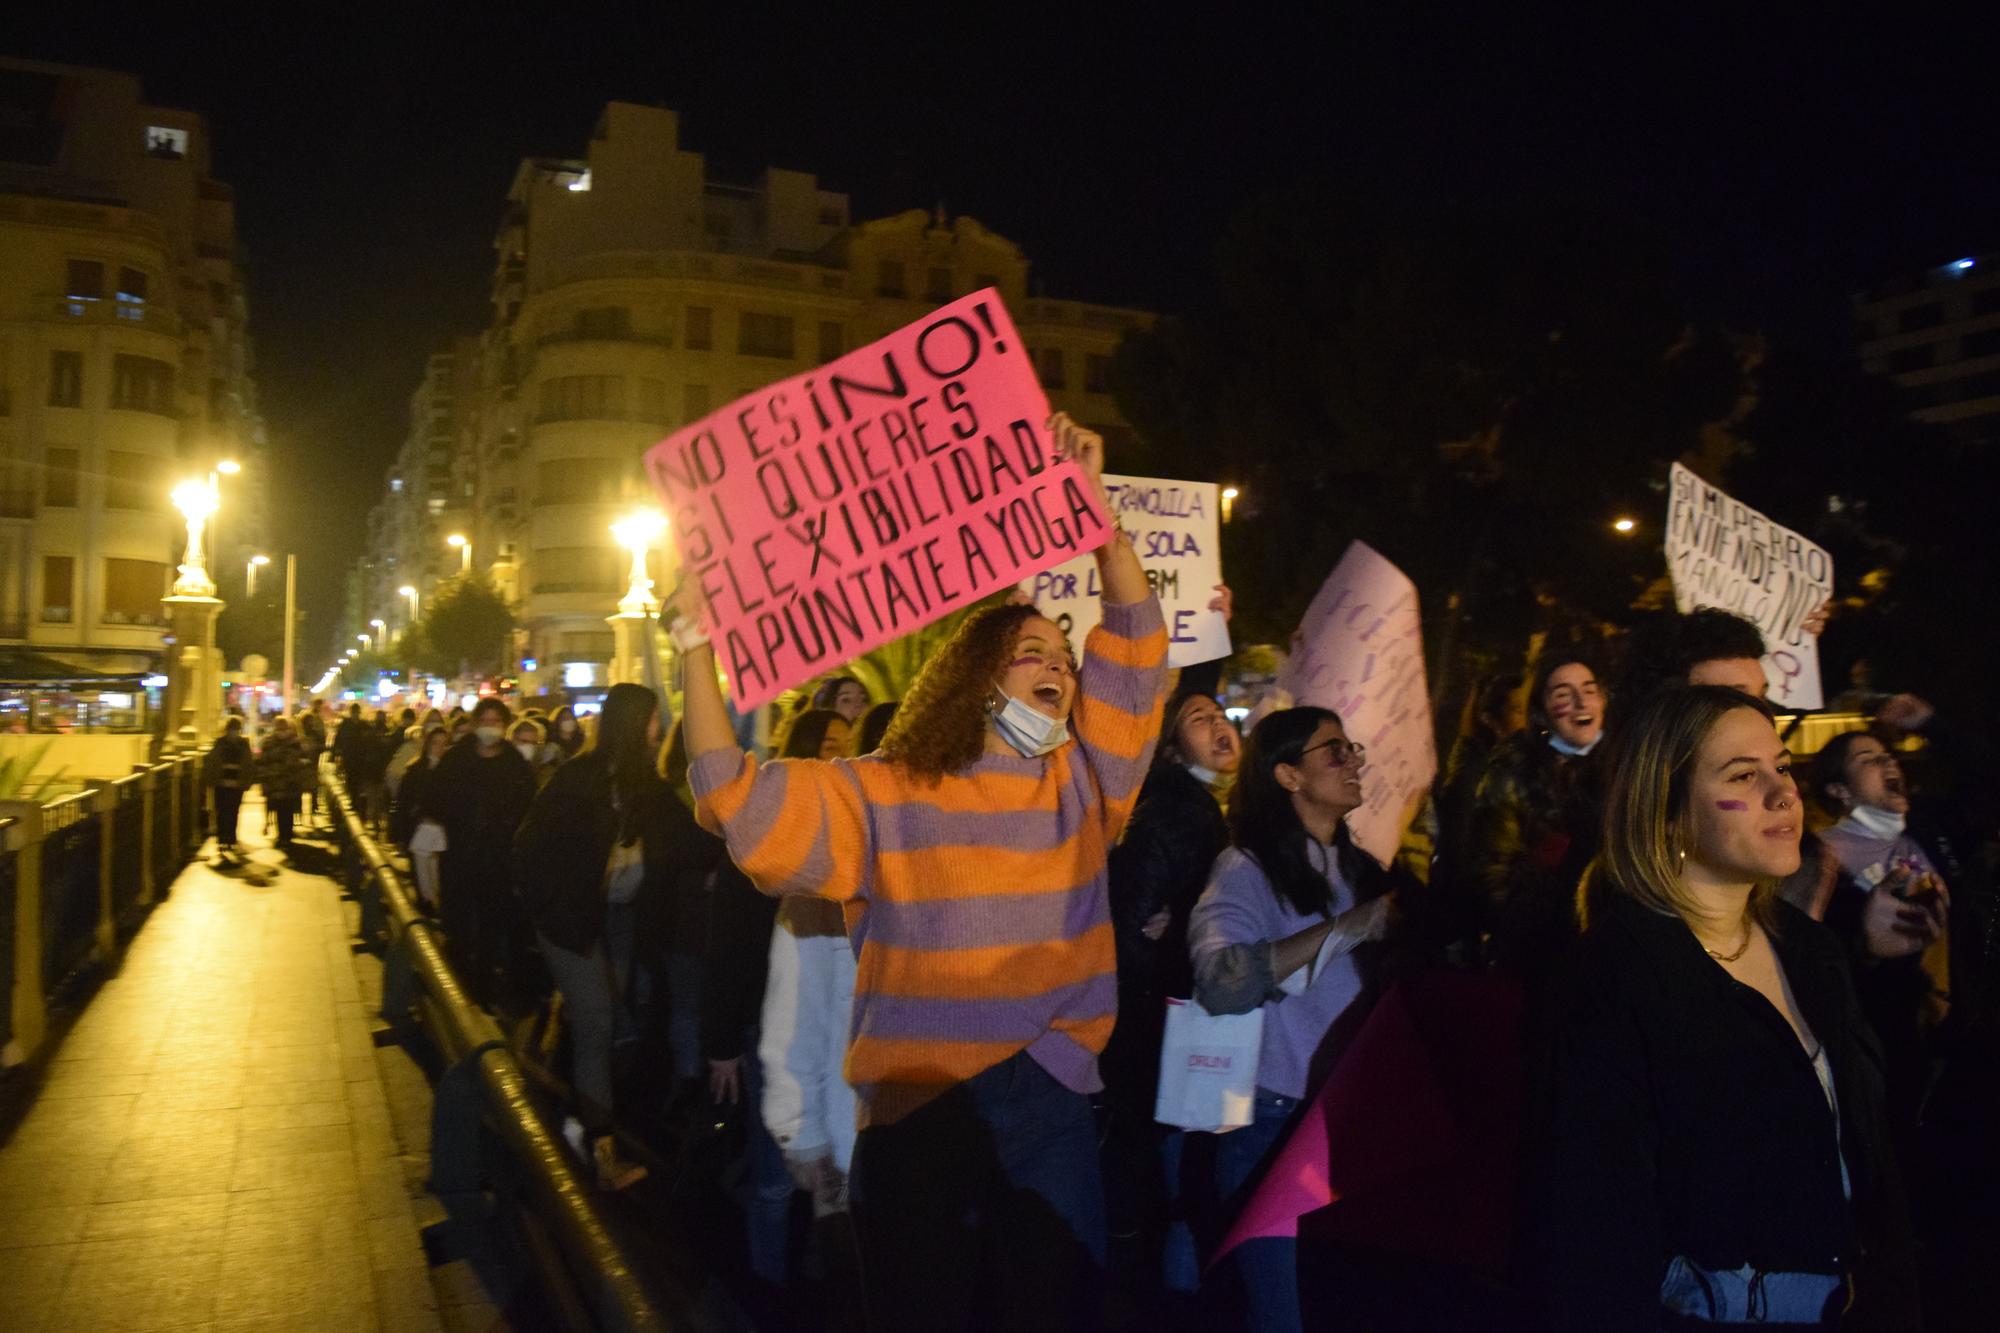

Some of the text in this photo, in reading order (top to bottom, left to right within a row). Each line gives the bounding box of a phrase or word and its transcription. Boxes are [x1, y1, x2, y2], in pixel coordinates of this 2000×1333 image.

[654, 427, 726, 504] NO
[738, 393, 801, 462] ES
[676, 381, 979, 564] SI QUIERES
[1143, 530, 1201, 558] SOLA
[1672, 499, 1783, 594] ENTIENDE
[1675, 470, 1828, 584] SI MI PERRO
[726, 476, 1105, 700] APÚNTATE A YOGA
[1033, 570, 1078, 601] POR
